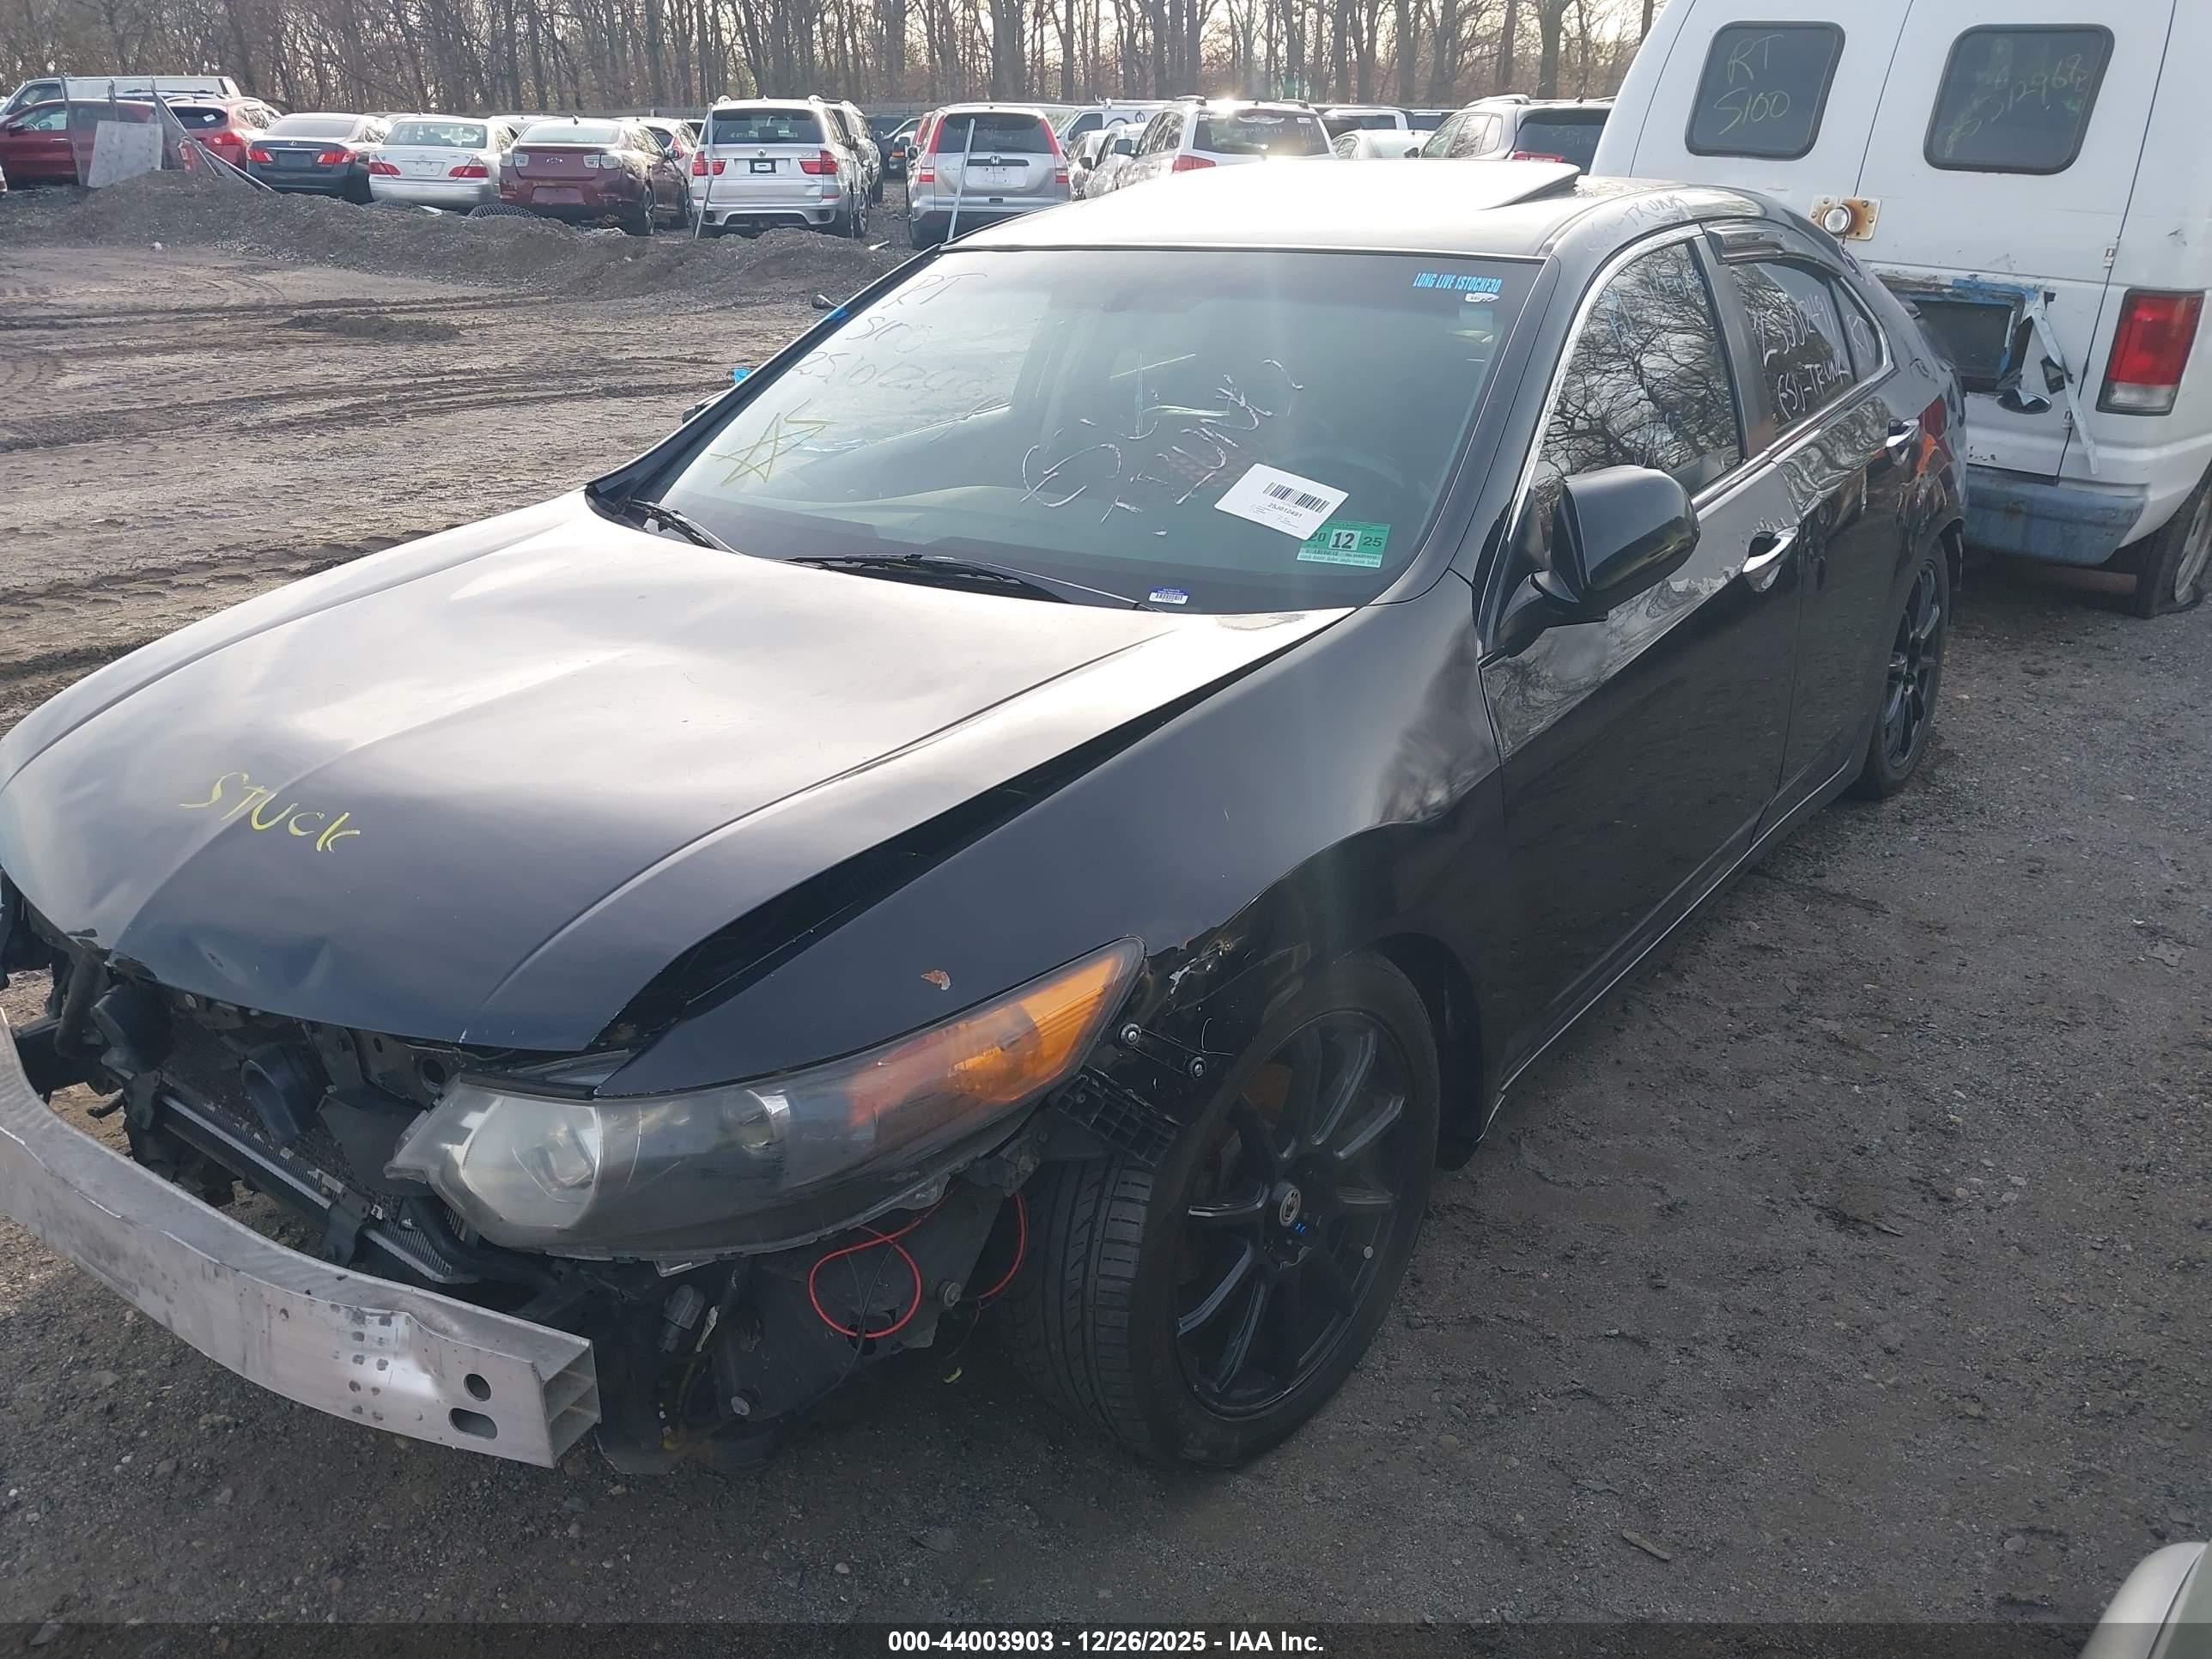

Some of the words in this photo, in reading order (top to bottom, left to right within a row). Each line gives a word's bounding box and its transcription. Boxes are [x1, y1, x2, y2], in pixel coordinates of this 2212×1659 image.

[1728, 33, 1784, 84] RT
[1713, 87, 1790, 136] S100
[881, 273, 988, 309] RT
[1413, 272, 1437, 288] LONG
[1435, 274, 1458, 289] LIVE
[1332, 532, 1355, 550] 12
[1362, 536, 1383, 547] 25
[178, 771, 362, 853] STUCK
